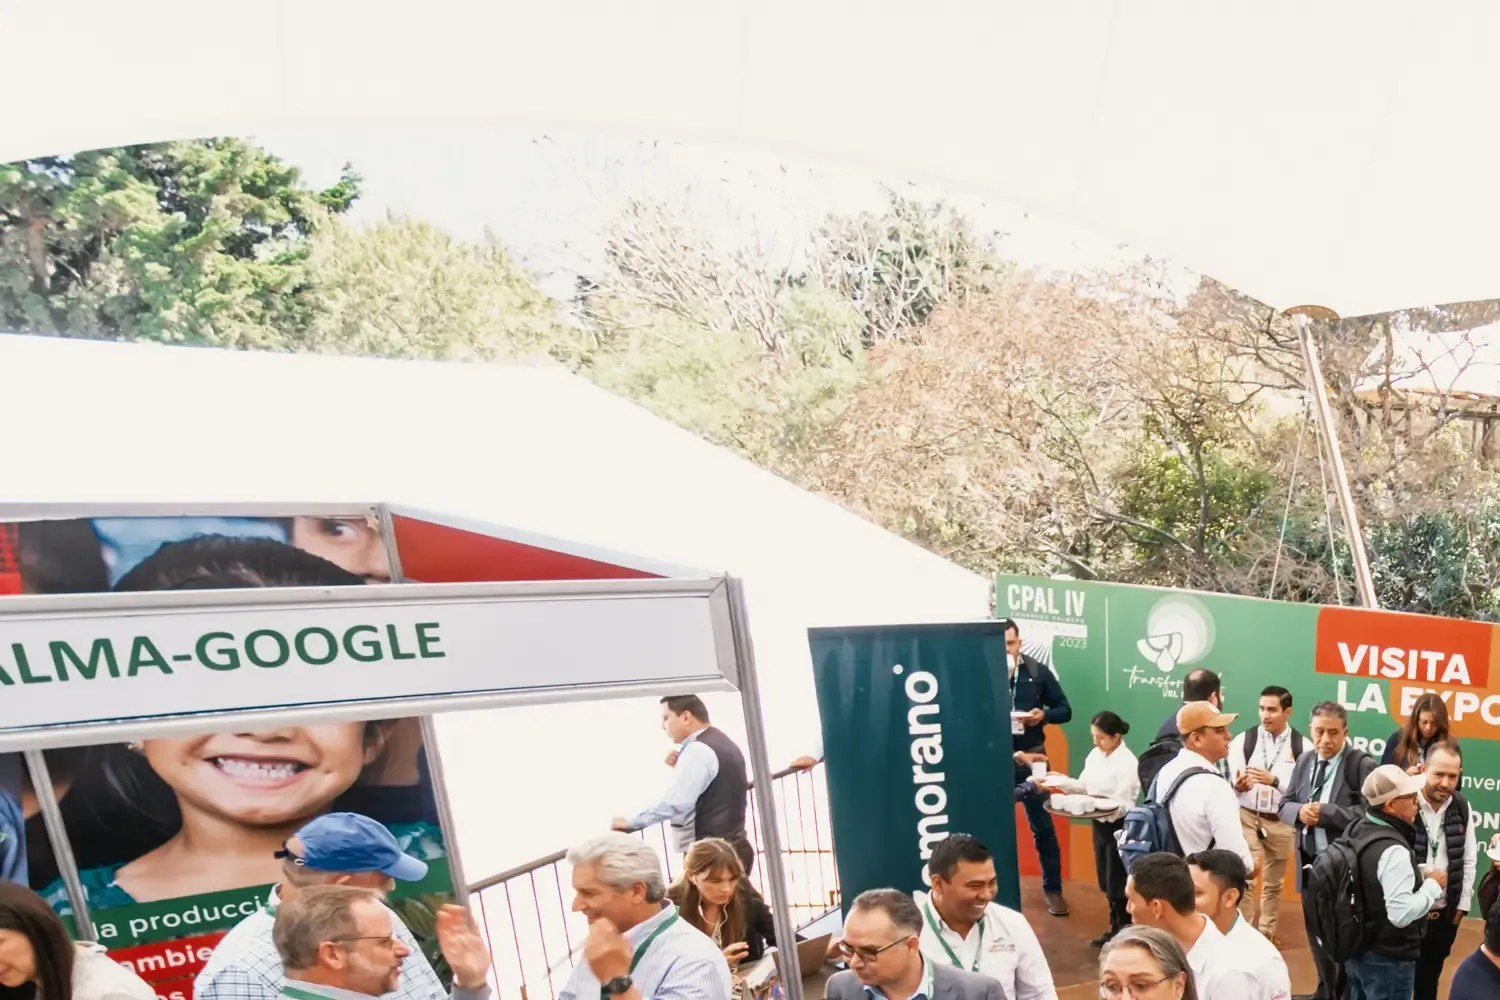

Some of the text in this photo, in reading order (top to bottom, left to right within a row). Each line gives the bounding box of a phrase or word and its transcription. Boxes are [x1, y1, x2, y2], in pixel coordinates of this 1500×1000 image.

[1007, 583, 1086, 617] CPAL IV
[1059, 636, 1087, 650] 2023
[1337, 642, 1471, 685] VISITA
[1337, 680, 1388, 715] LA
[903, 670, 950, 905] morano
[93, 895, 262, 940] la producci
[118, 945, 212, 976] ambie
